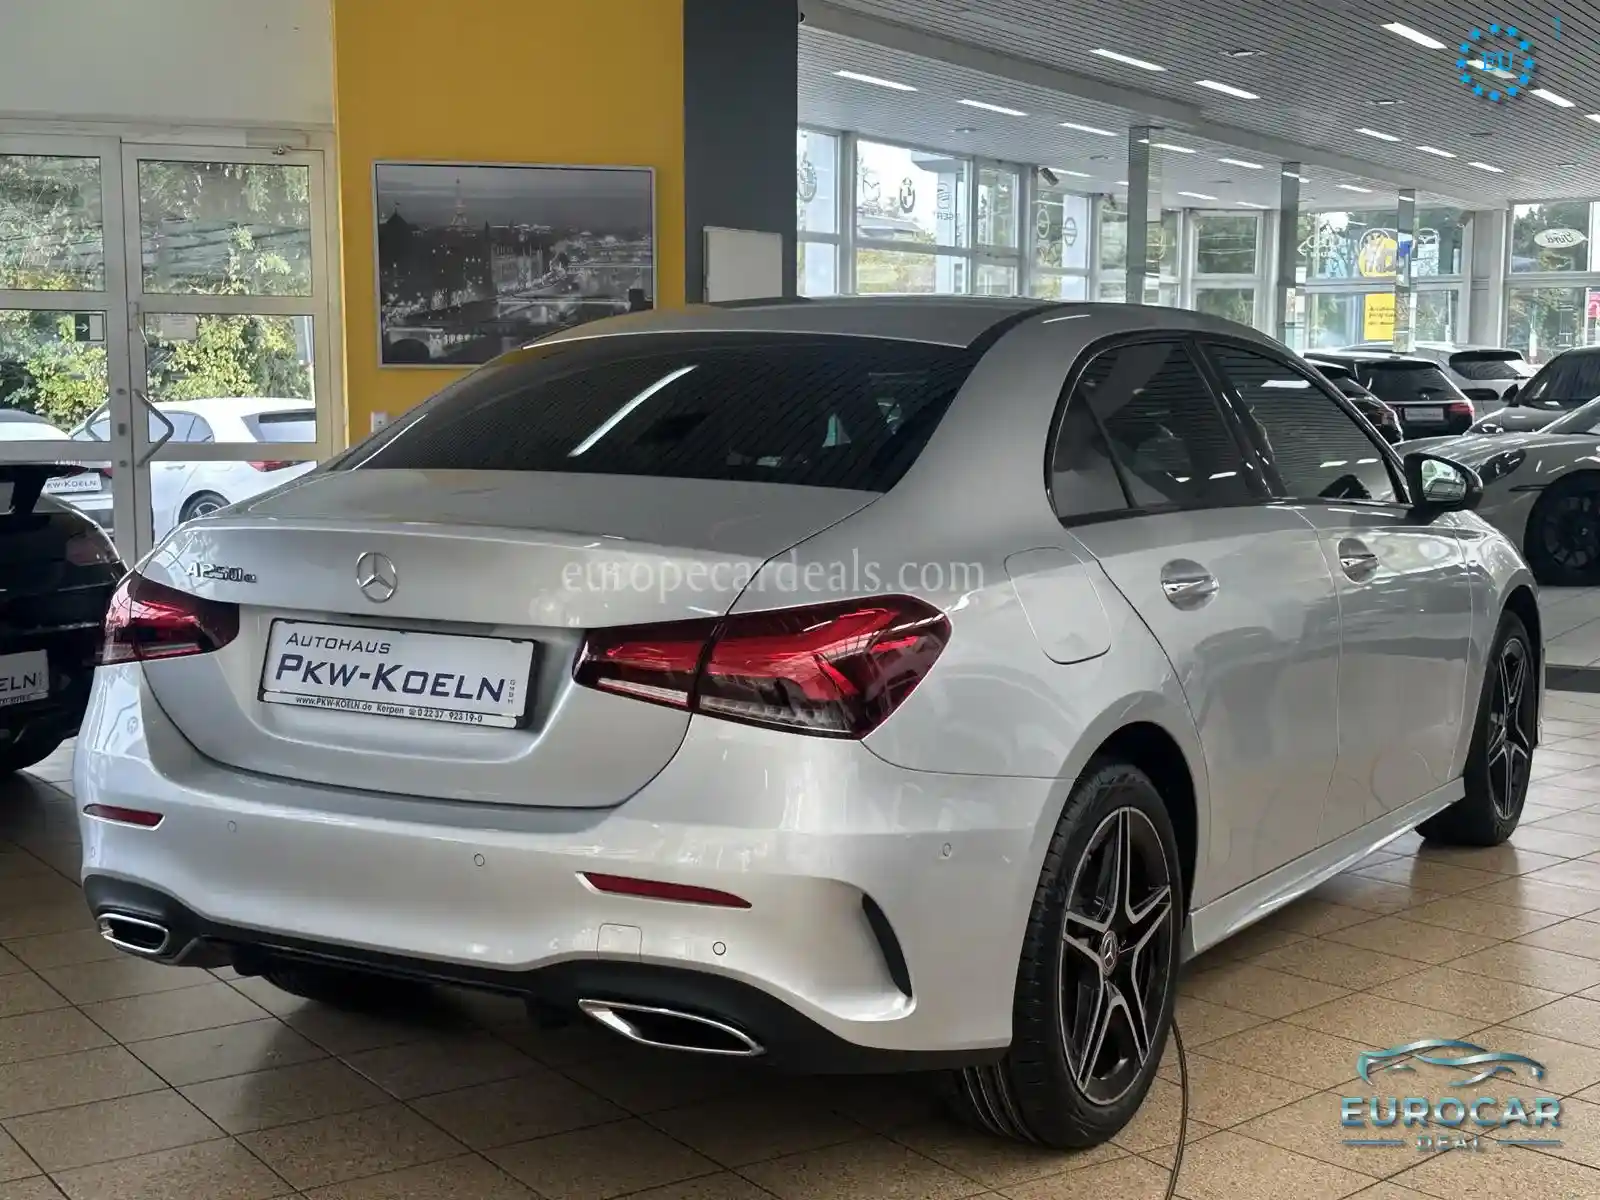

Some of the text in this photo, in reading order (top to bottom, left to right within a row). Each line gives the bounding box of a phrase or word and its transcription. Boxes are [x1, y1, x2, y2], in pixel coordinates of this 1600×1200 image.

[286, 632, 391, 655] AUTOHAUS
[275, 654, 506, 703] PKW-KOELN
[376, 703, 405, 715] Kerpen
